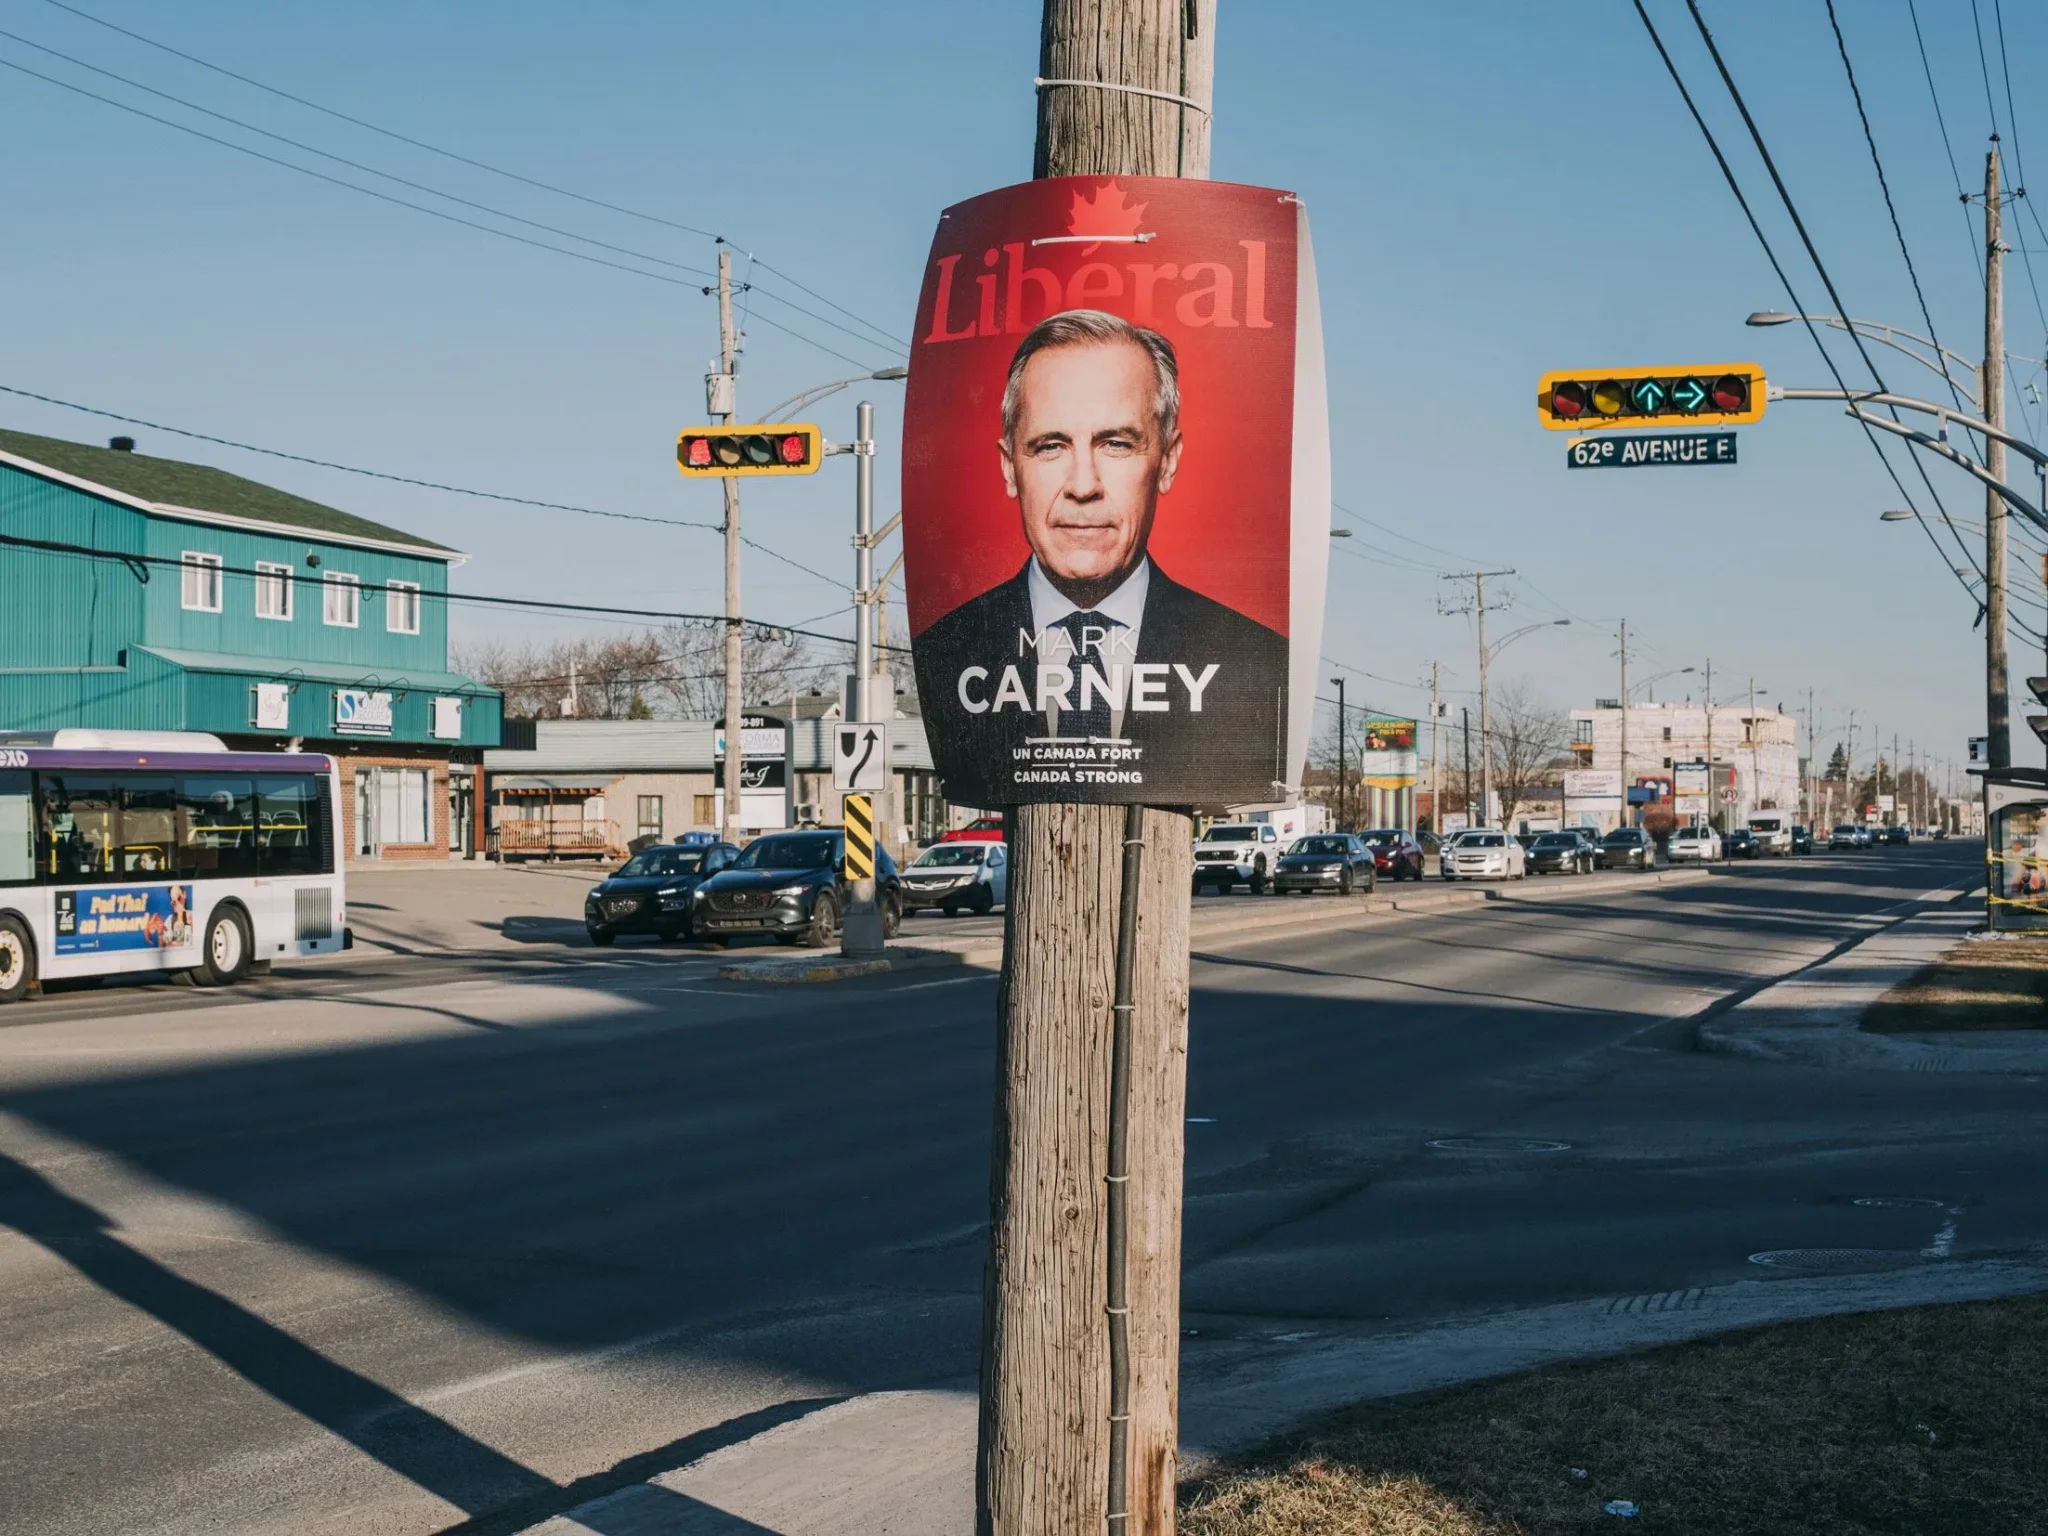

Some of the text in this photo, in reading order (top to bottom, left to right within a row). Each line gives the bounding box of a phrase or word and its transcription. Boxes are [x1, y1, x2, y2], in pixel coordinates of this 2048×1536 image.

[1574, 441, 1614, 464] 62e
[1621, 439, 1708, 463] AVENUE
[1018, 625, 1138, 658] MARK
[957, 663, 1221, 714] CARNEY
[1012, 747, 1142, 760] UN CANADA FORT
[1014, 770, 1143, 784] CANADA STRONG
